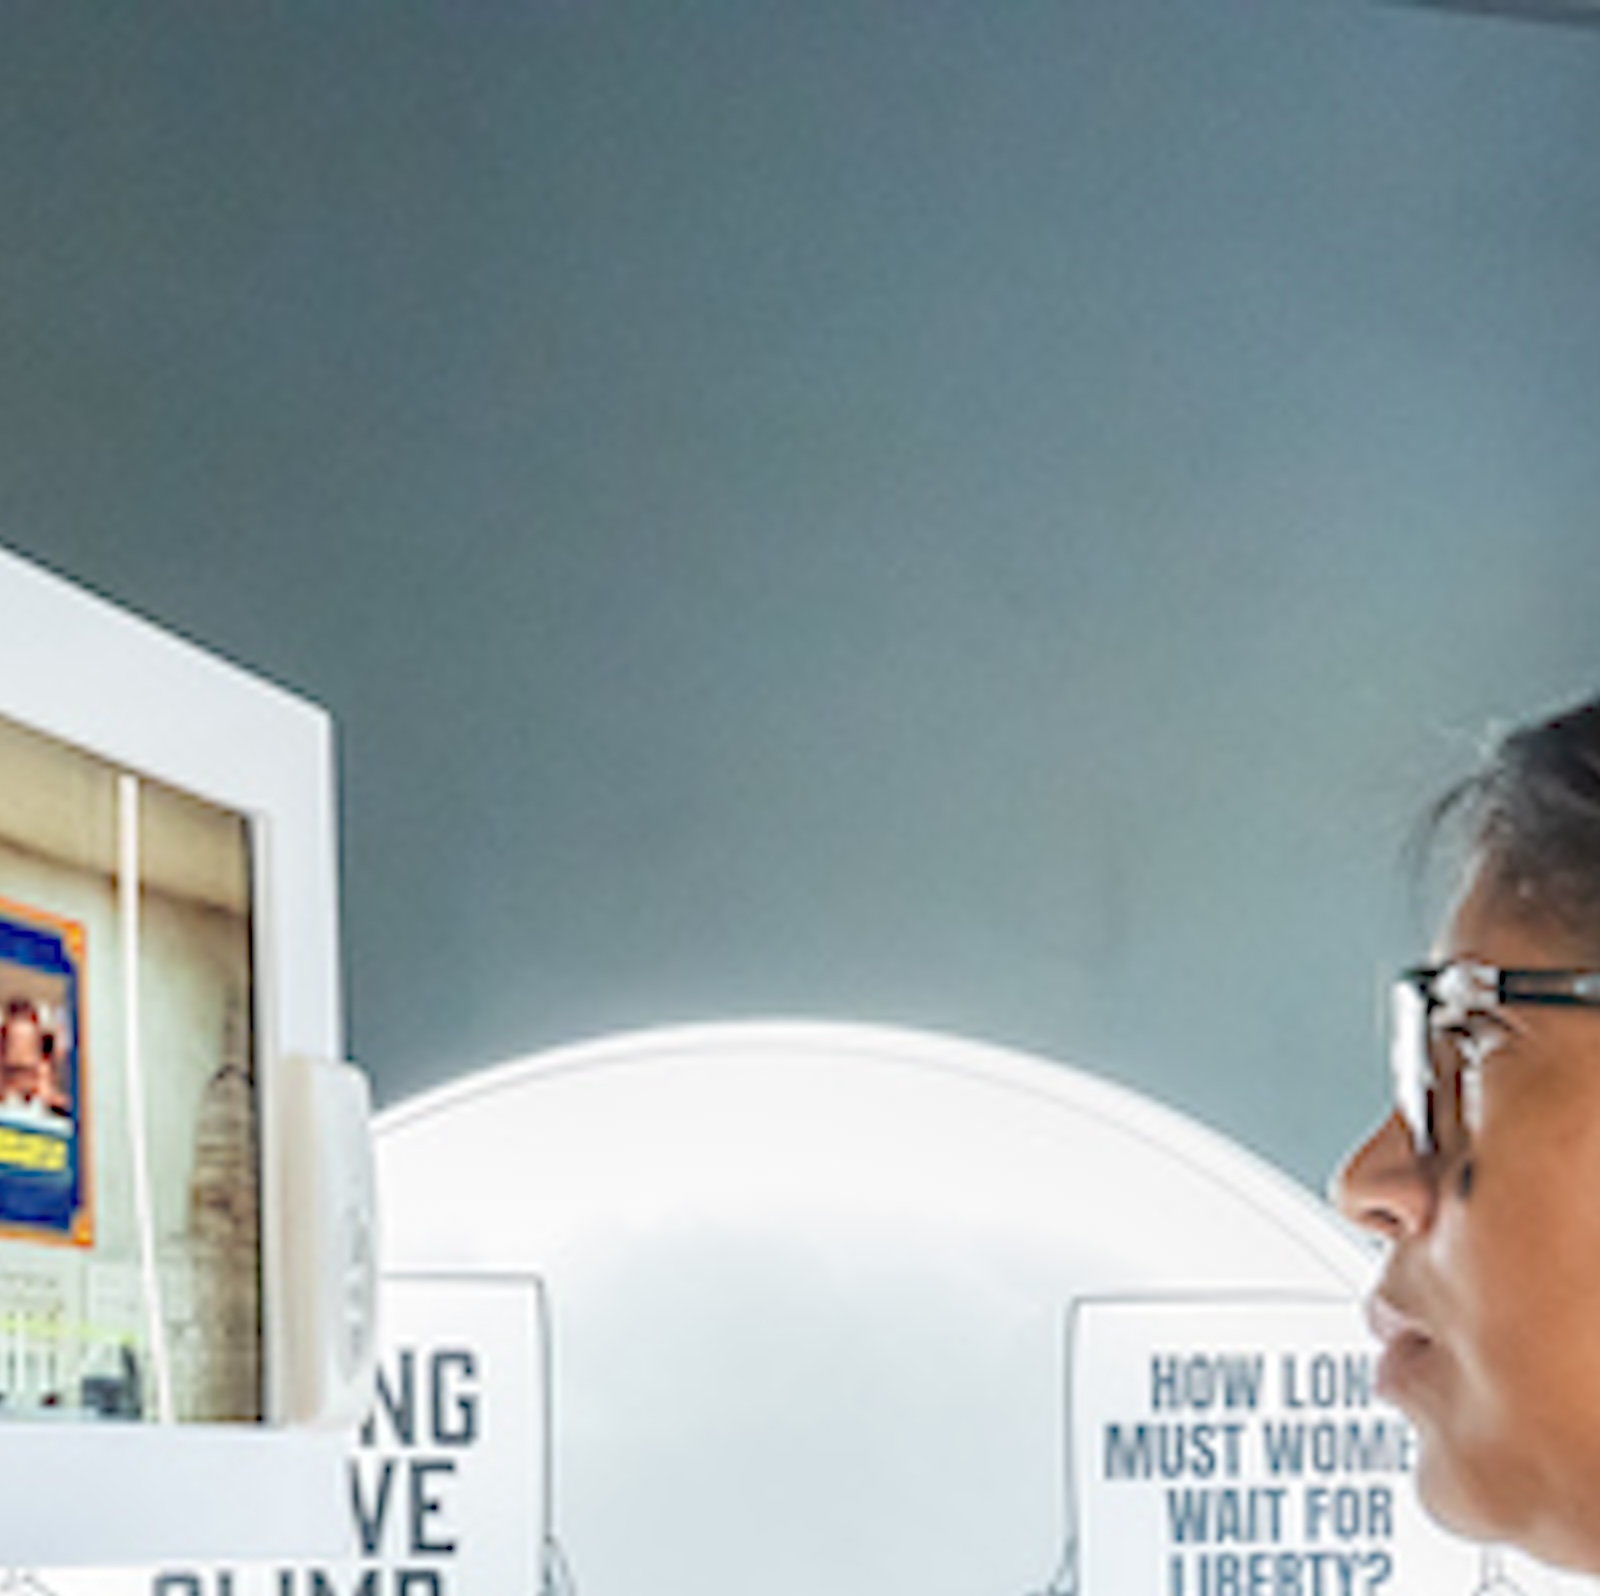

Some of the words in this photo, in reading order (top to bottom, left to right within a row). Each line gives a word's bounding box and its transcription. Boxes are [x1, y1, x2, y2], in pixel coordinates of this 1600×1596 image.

[359, 1349, 478, 1447] NG
[1150, 1353, 1264, 1411] HOW
[1282, 1352, 1370, 1409] LON
[1103, 1422, 1246, 1481] MUST
[1264, 1420, 1414, 1478] WOME
[1165, 1487, 1288, 1544] WAIT
[1304, 1486, 1394, 1540] FOR
